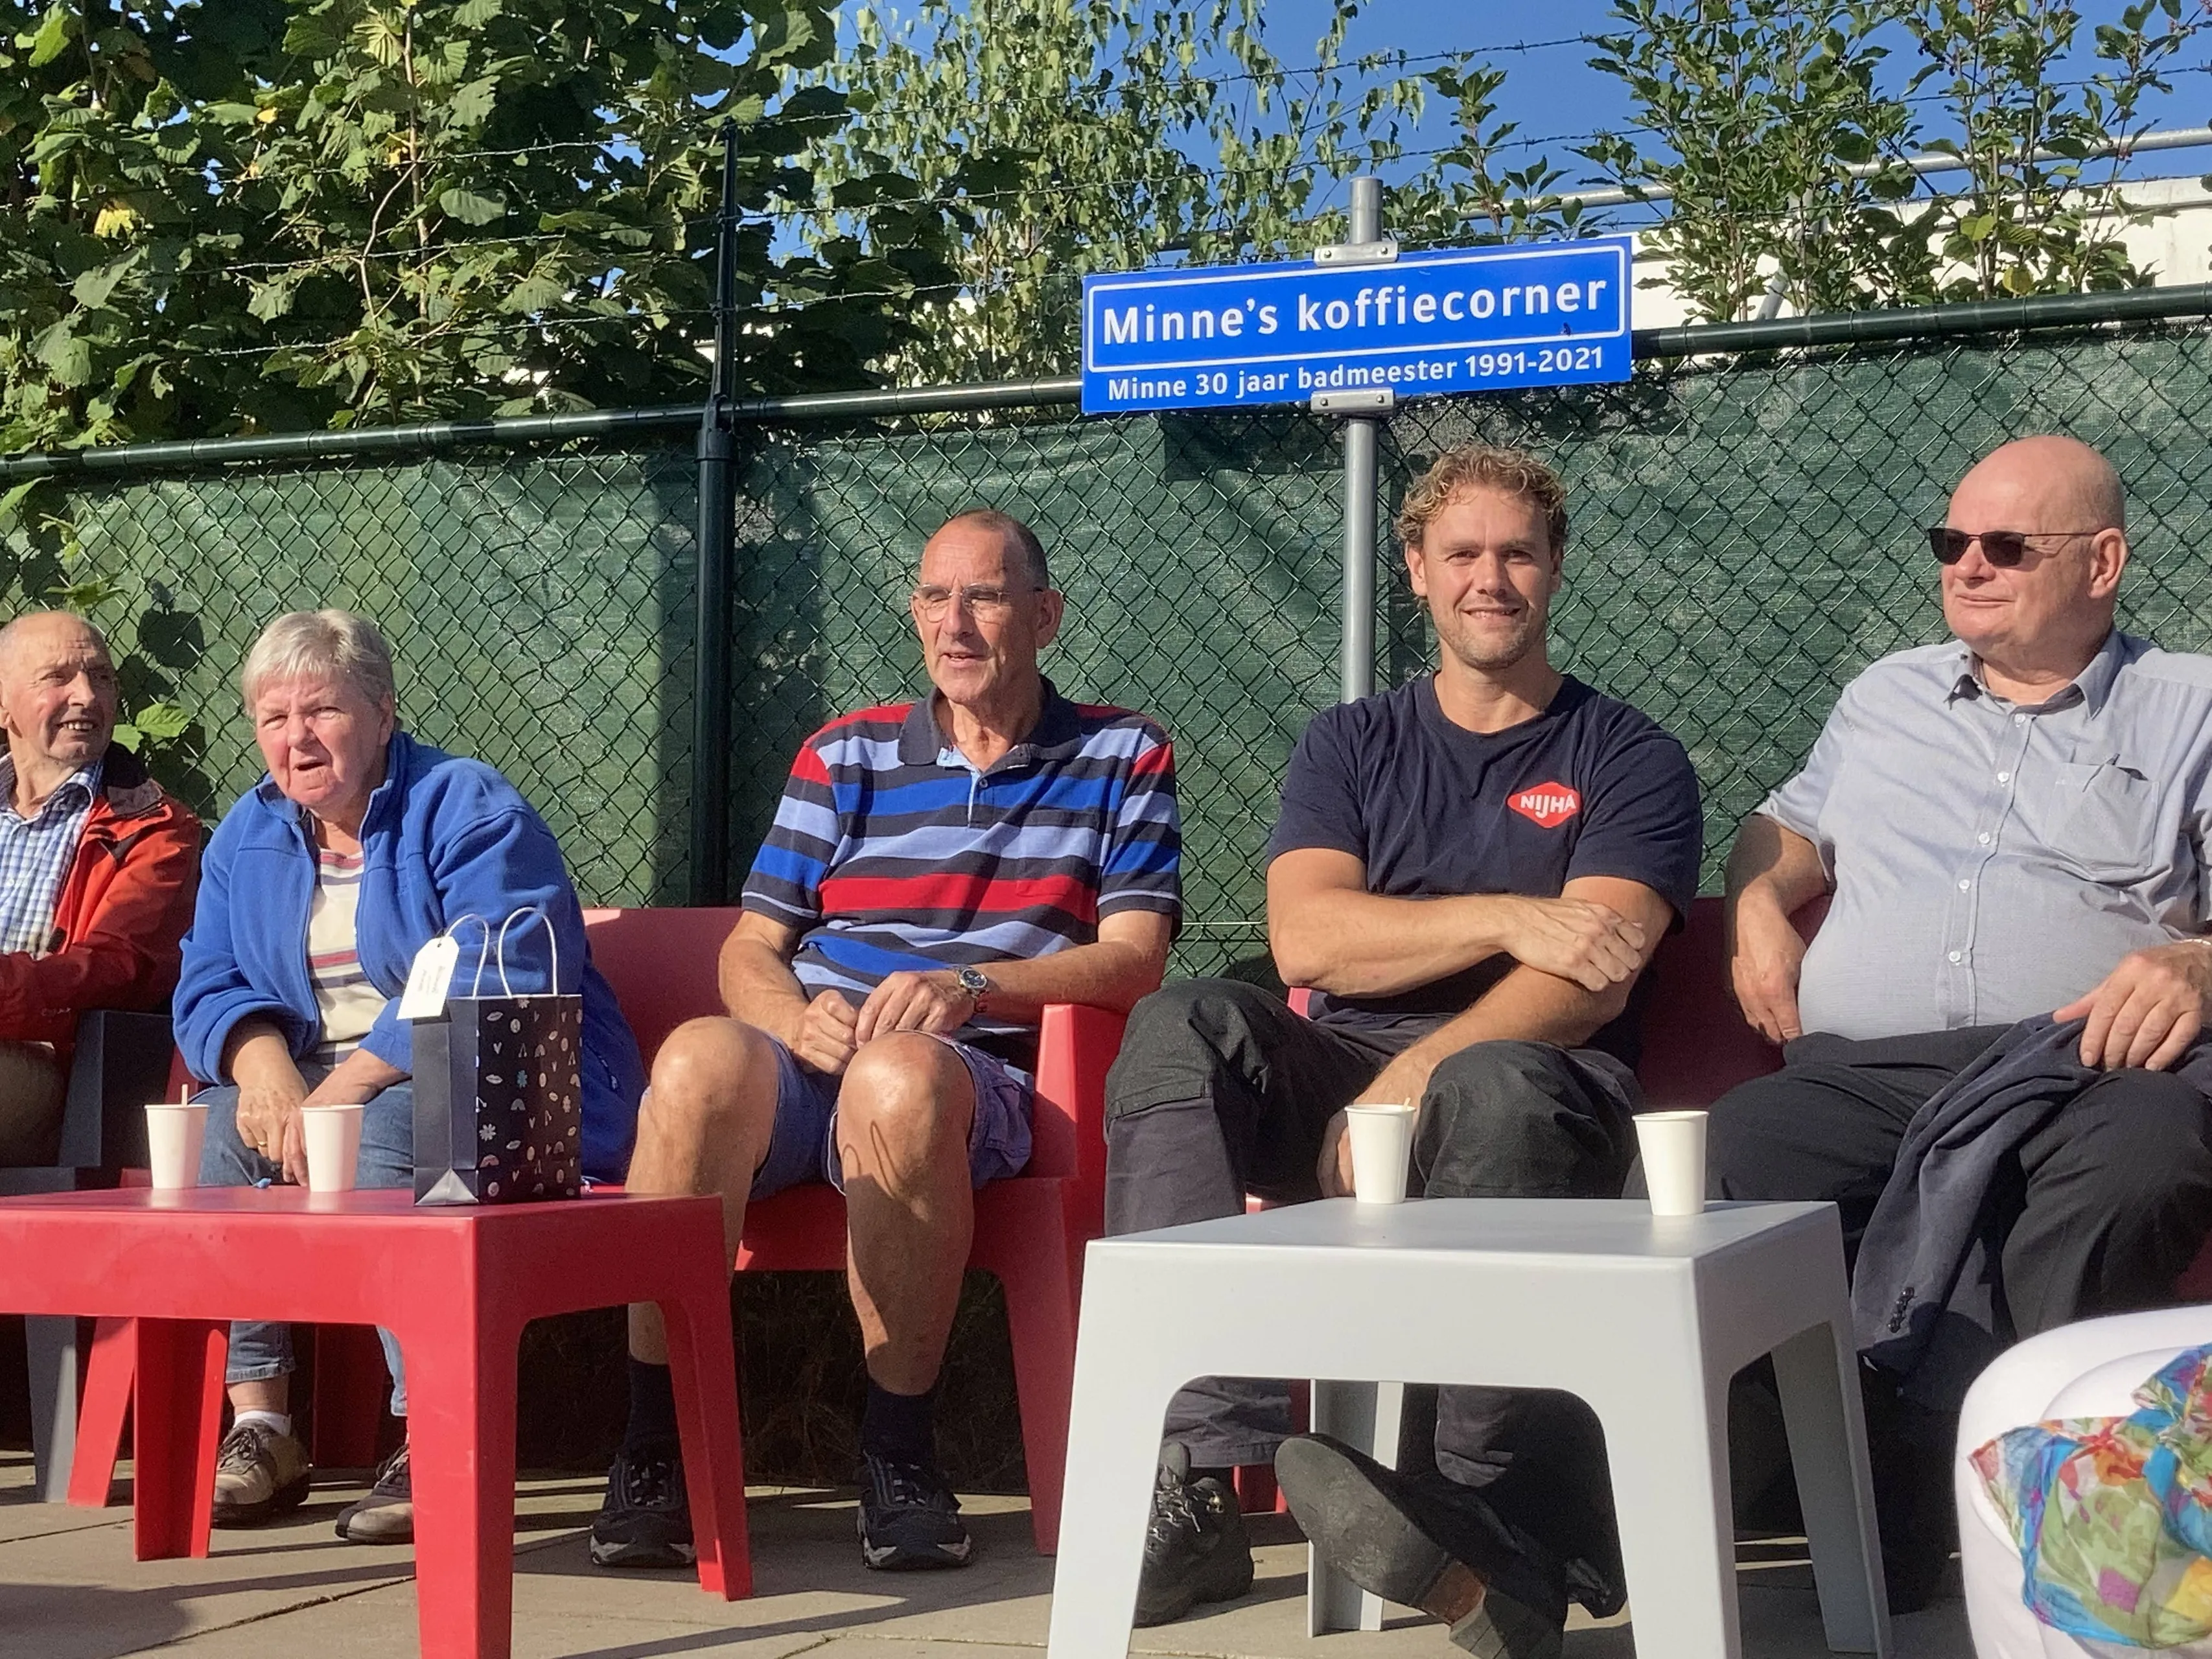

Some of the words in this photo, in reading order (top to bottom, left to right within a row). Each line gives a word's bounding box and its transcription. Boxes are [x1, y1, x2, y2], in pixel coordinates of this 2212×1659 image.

[1103, 298, 1278, 345] Minne's
[1298, 280, 1607, 331] koffiecorner
[1108, 377, 1187, 400] Minne
[1195, 373, 1228, 395] 30
[1235, 369, 1289, 399] jaar
[1298, 360, 1458, 389] badmeester
[1465, 346, 1602, 377] 1991-2021
[1520, 794, 1576, 818] NIJHA
